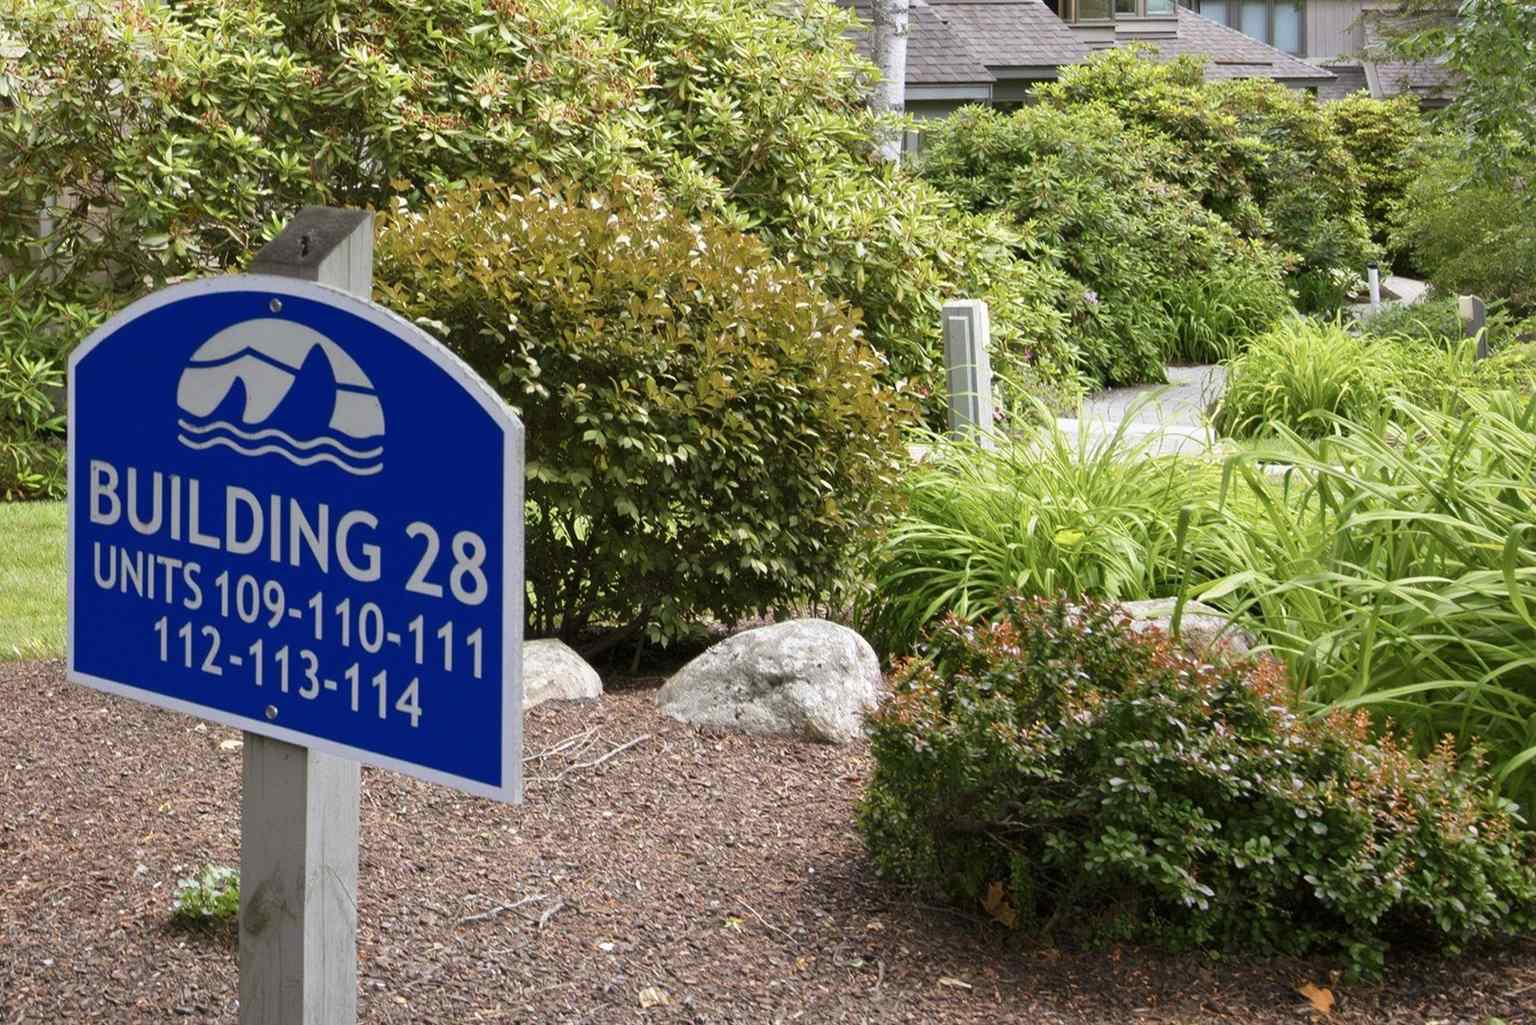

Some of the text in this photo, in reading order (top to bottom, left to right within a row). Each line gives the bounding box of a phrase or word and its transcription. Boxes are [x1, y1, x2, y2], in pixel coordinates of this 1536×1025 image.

[89, 459, 489, 606] BUILDING 28
[93, 541, 483, 679] UNITS 109-110-111
[154, 615, 423, 728] 112-113-114
